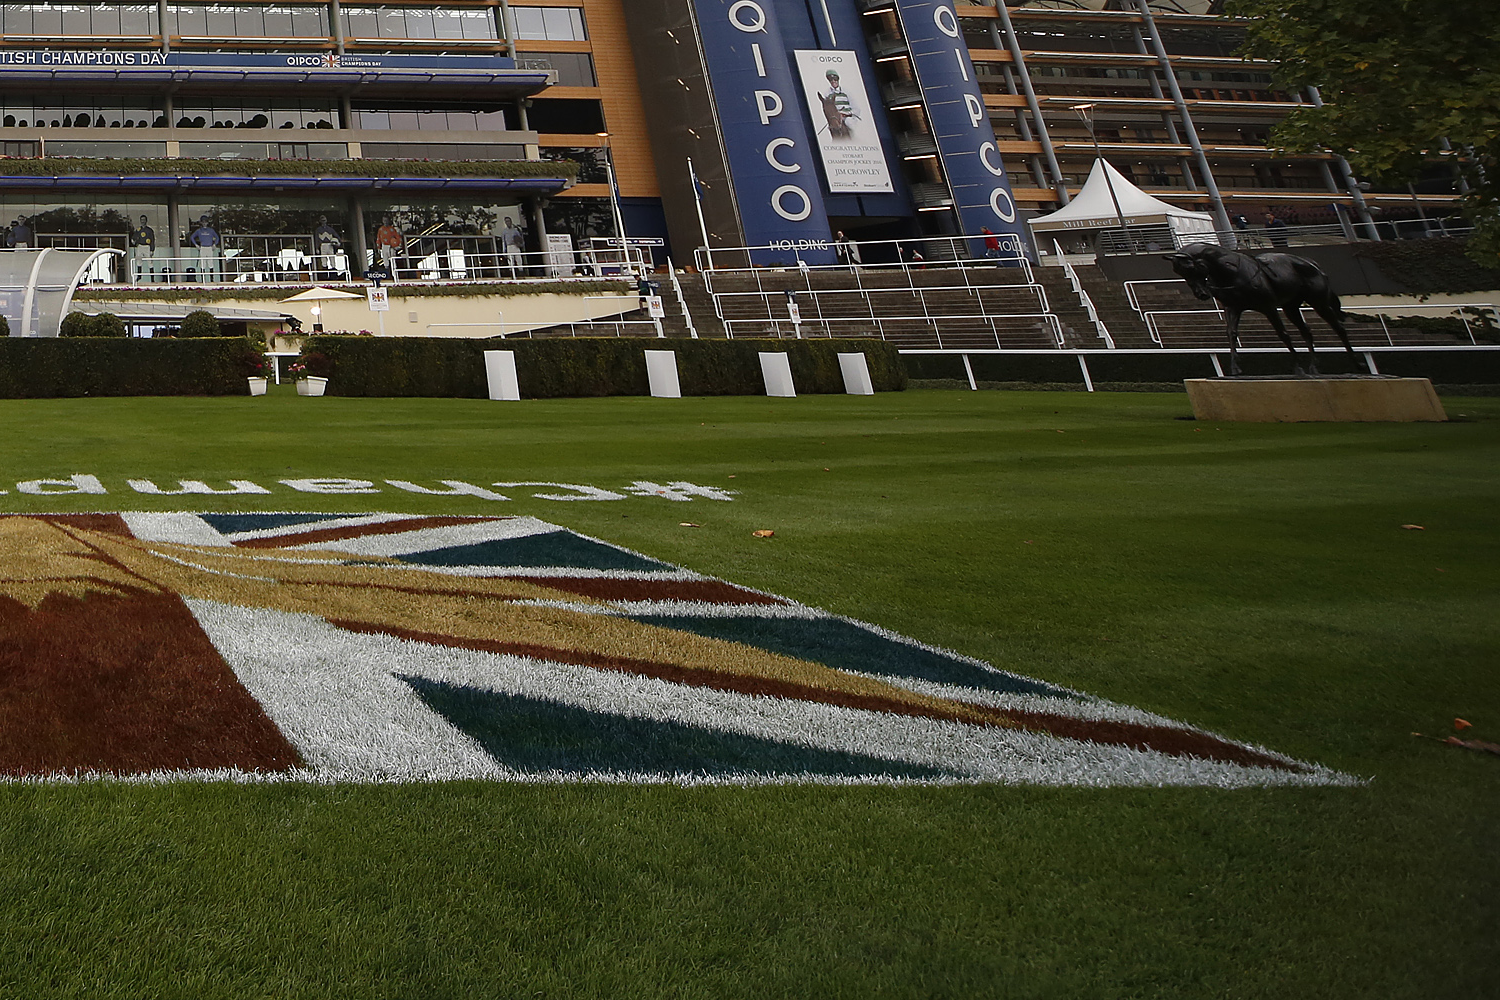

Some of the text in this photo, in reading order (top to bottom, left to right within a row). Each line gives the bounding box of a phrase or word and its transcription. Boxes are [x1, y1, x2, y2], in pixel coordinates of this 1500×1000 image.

[41, 52, 135, 64] CHAMPIONS
[140, 53, 169, 65] DAY
[286, 56, 321, 66] QIPCO
[728, 0, 812, 222] QIPCO
[933, 5, 1016, 225] QIPCO
[835, 168, 847, 176] JIM
[1063, 220, 1084, 228] Mill
[1088, 218, 1113, 226] Reef
[769, 239, 828, 251] HOLDING
